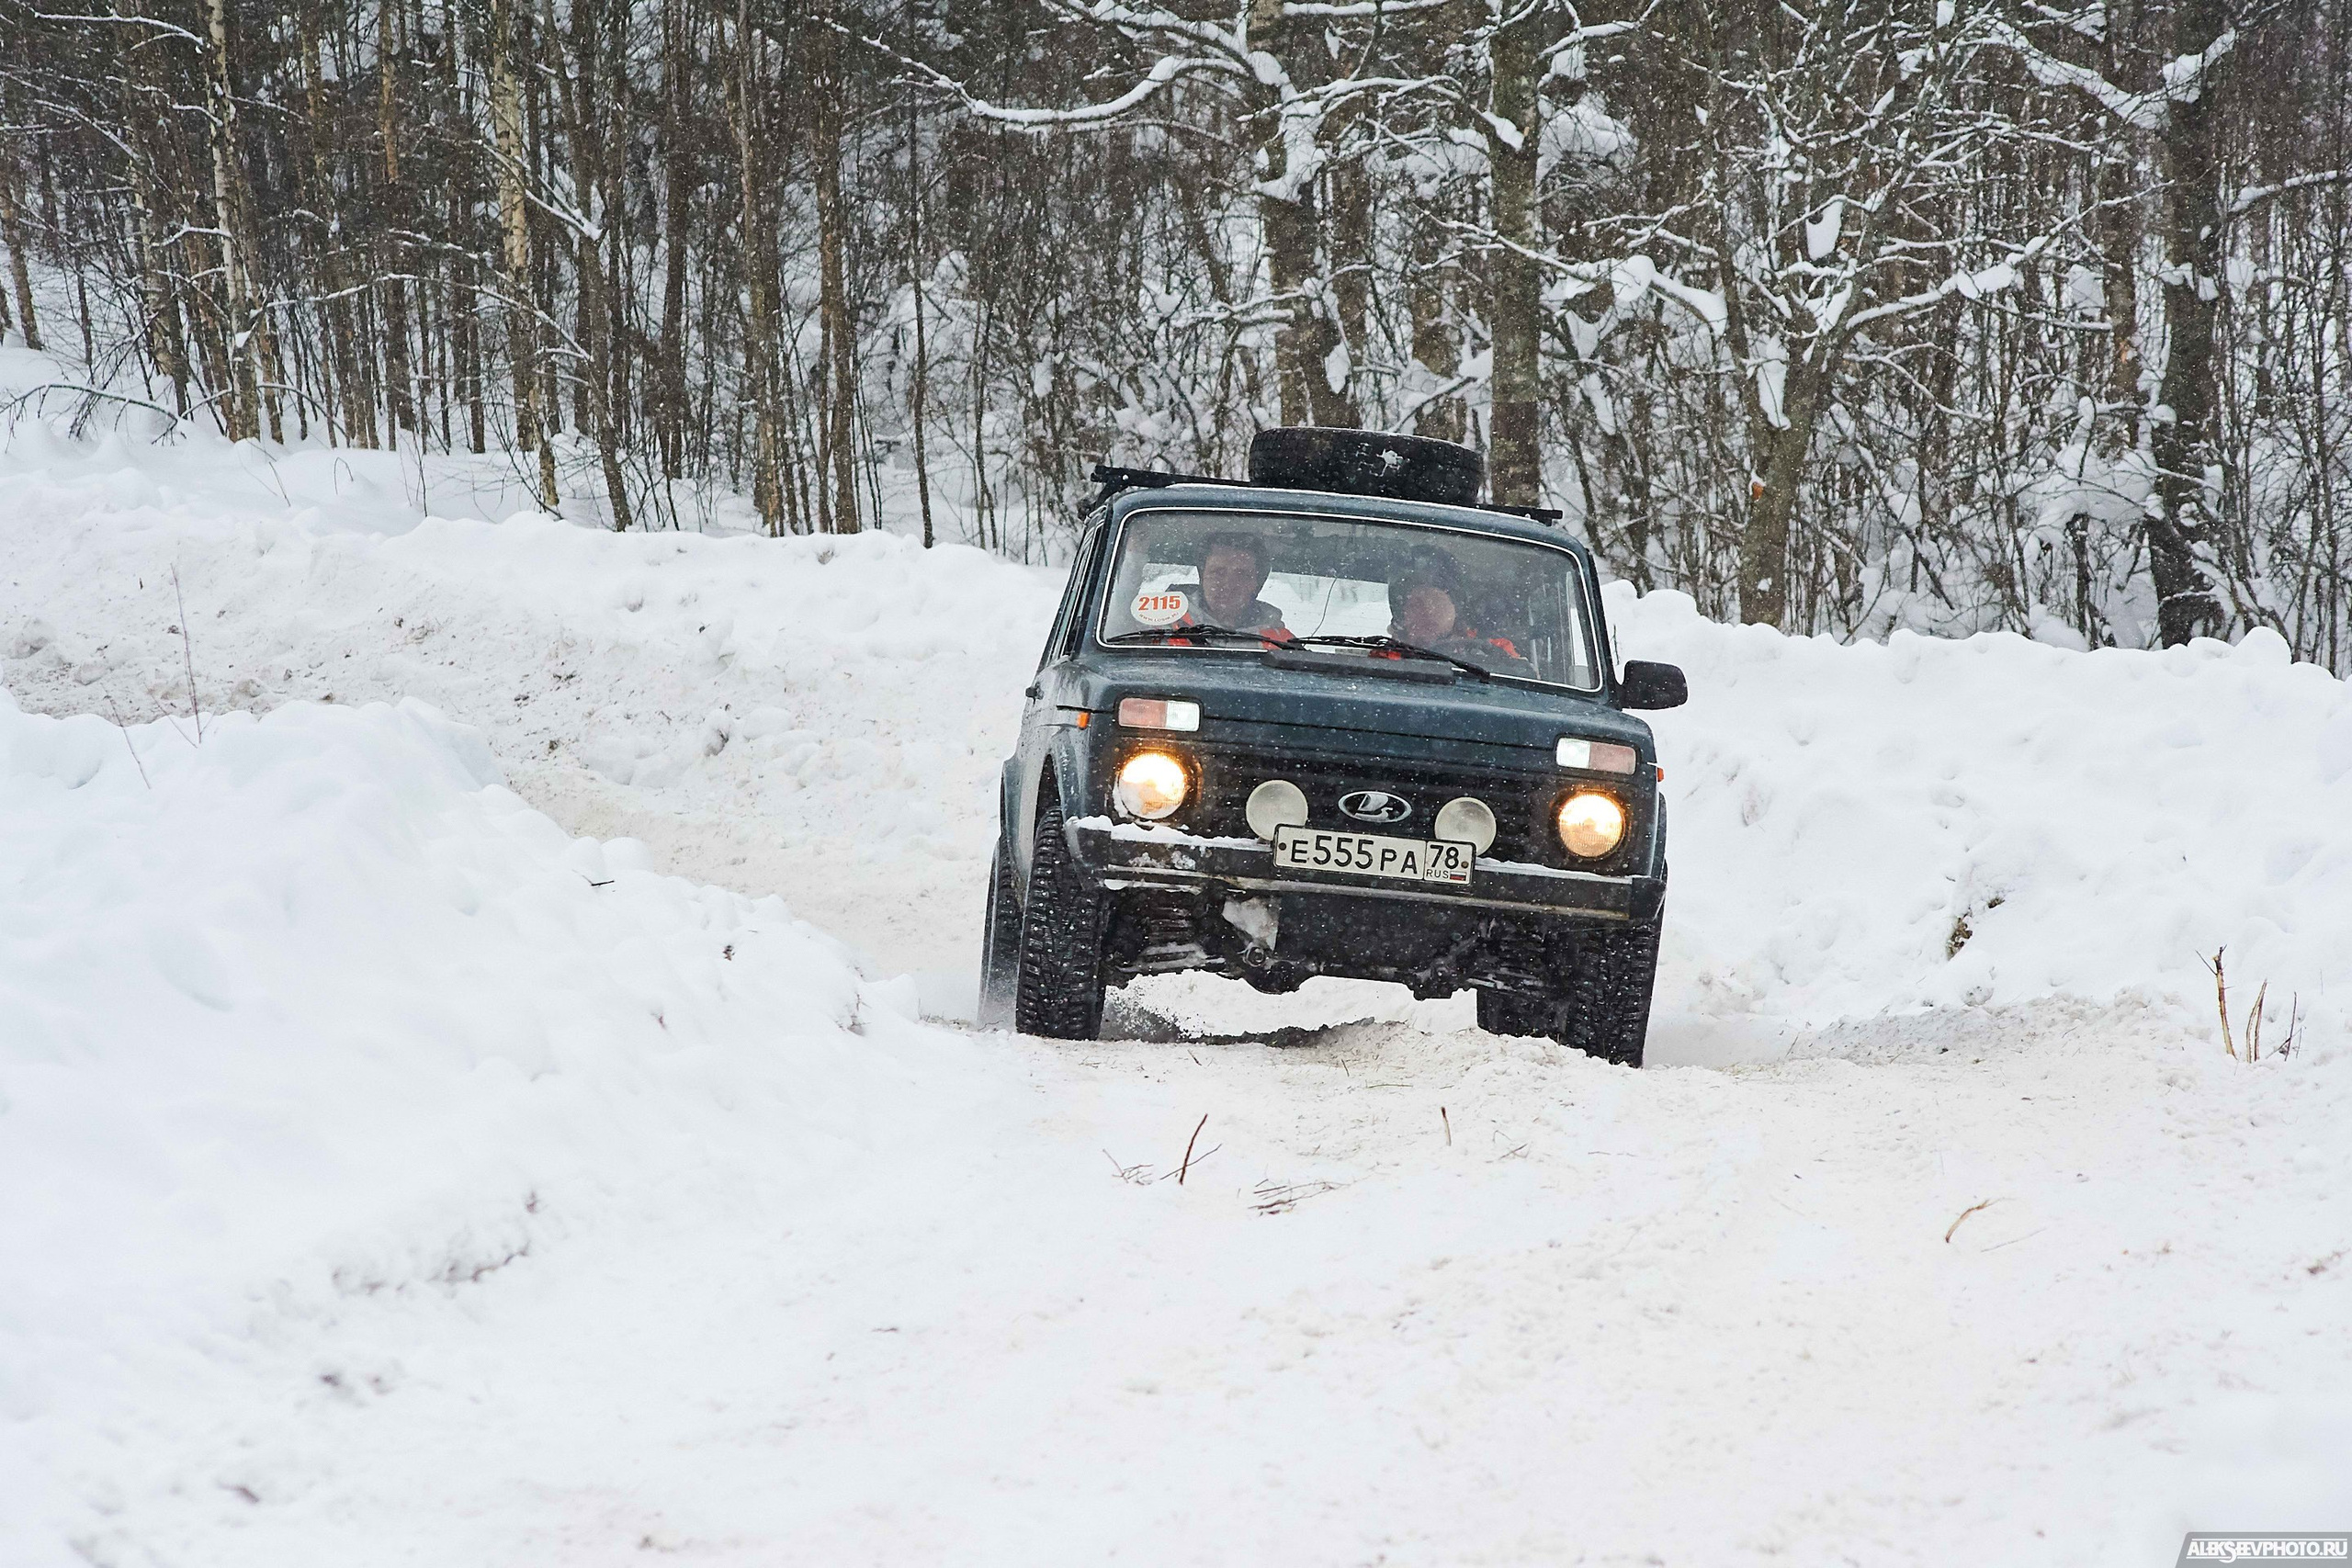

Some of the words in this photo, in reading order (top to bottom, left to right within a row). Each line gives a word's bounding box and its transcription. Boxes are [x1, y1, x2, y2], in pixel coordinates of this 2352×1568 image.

[1138, 595, 1181, 611] 2115
[1430, 844, 1459, 869] 78
[1426, 868, 1449, 879] RUS
